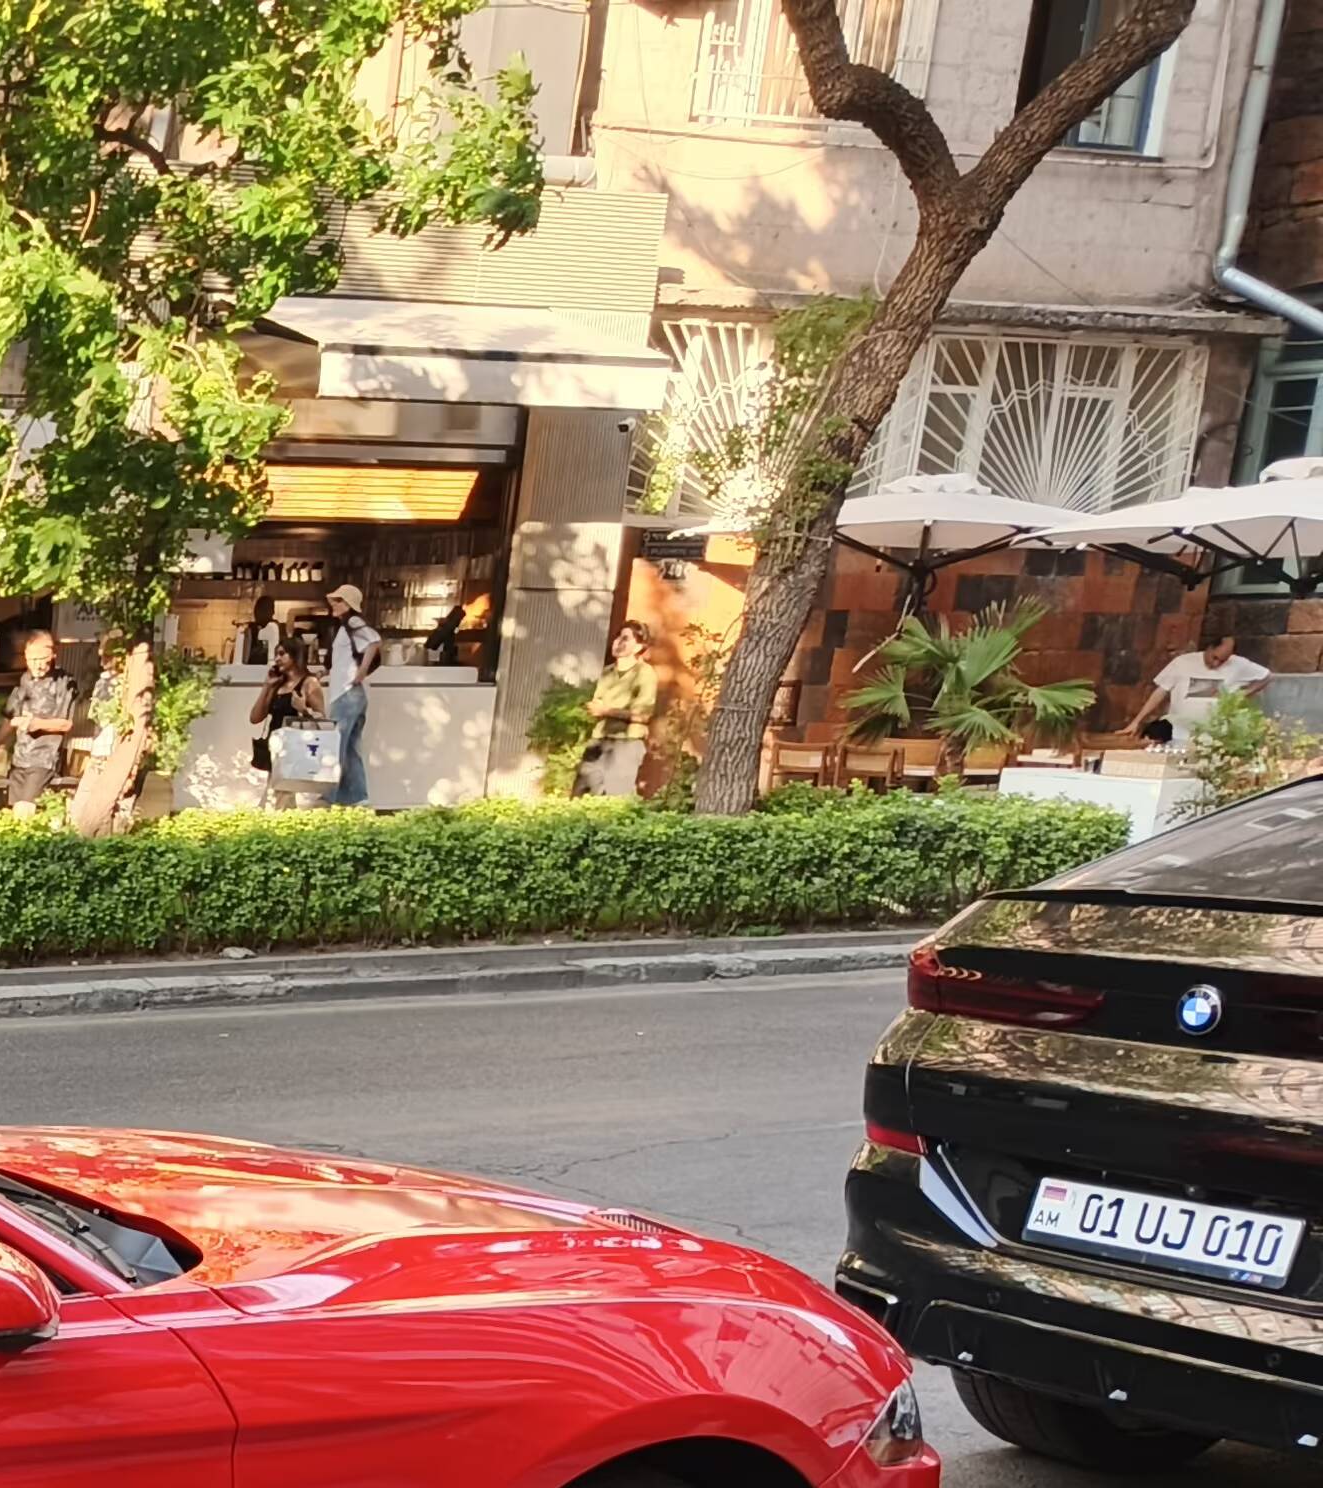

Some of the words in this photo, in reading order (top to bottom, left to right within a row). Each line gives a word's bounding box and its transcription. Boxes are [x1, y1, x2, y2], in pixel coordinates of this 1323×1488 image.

[1033, 1209, 1061, 1227] AM
[1079, 1193, 1125, 1239] 01
[1135, 1202, 1195, 1250] UJ
[1202, 1215, 1284, 1267] 010
